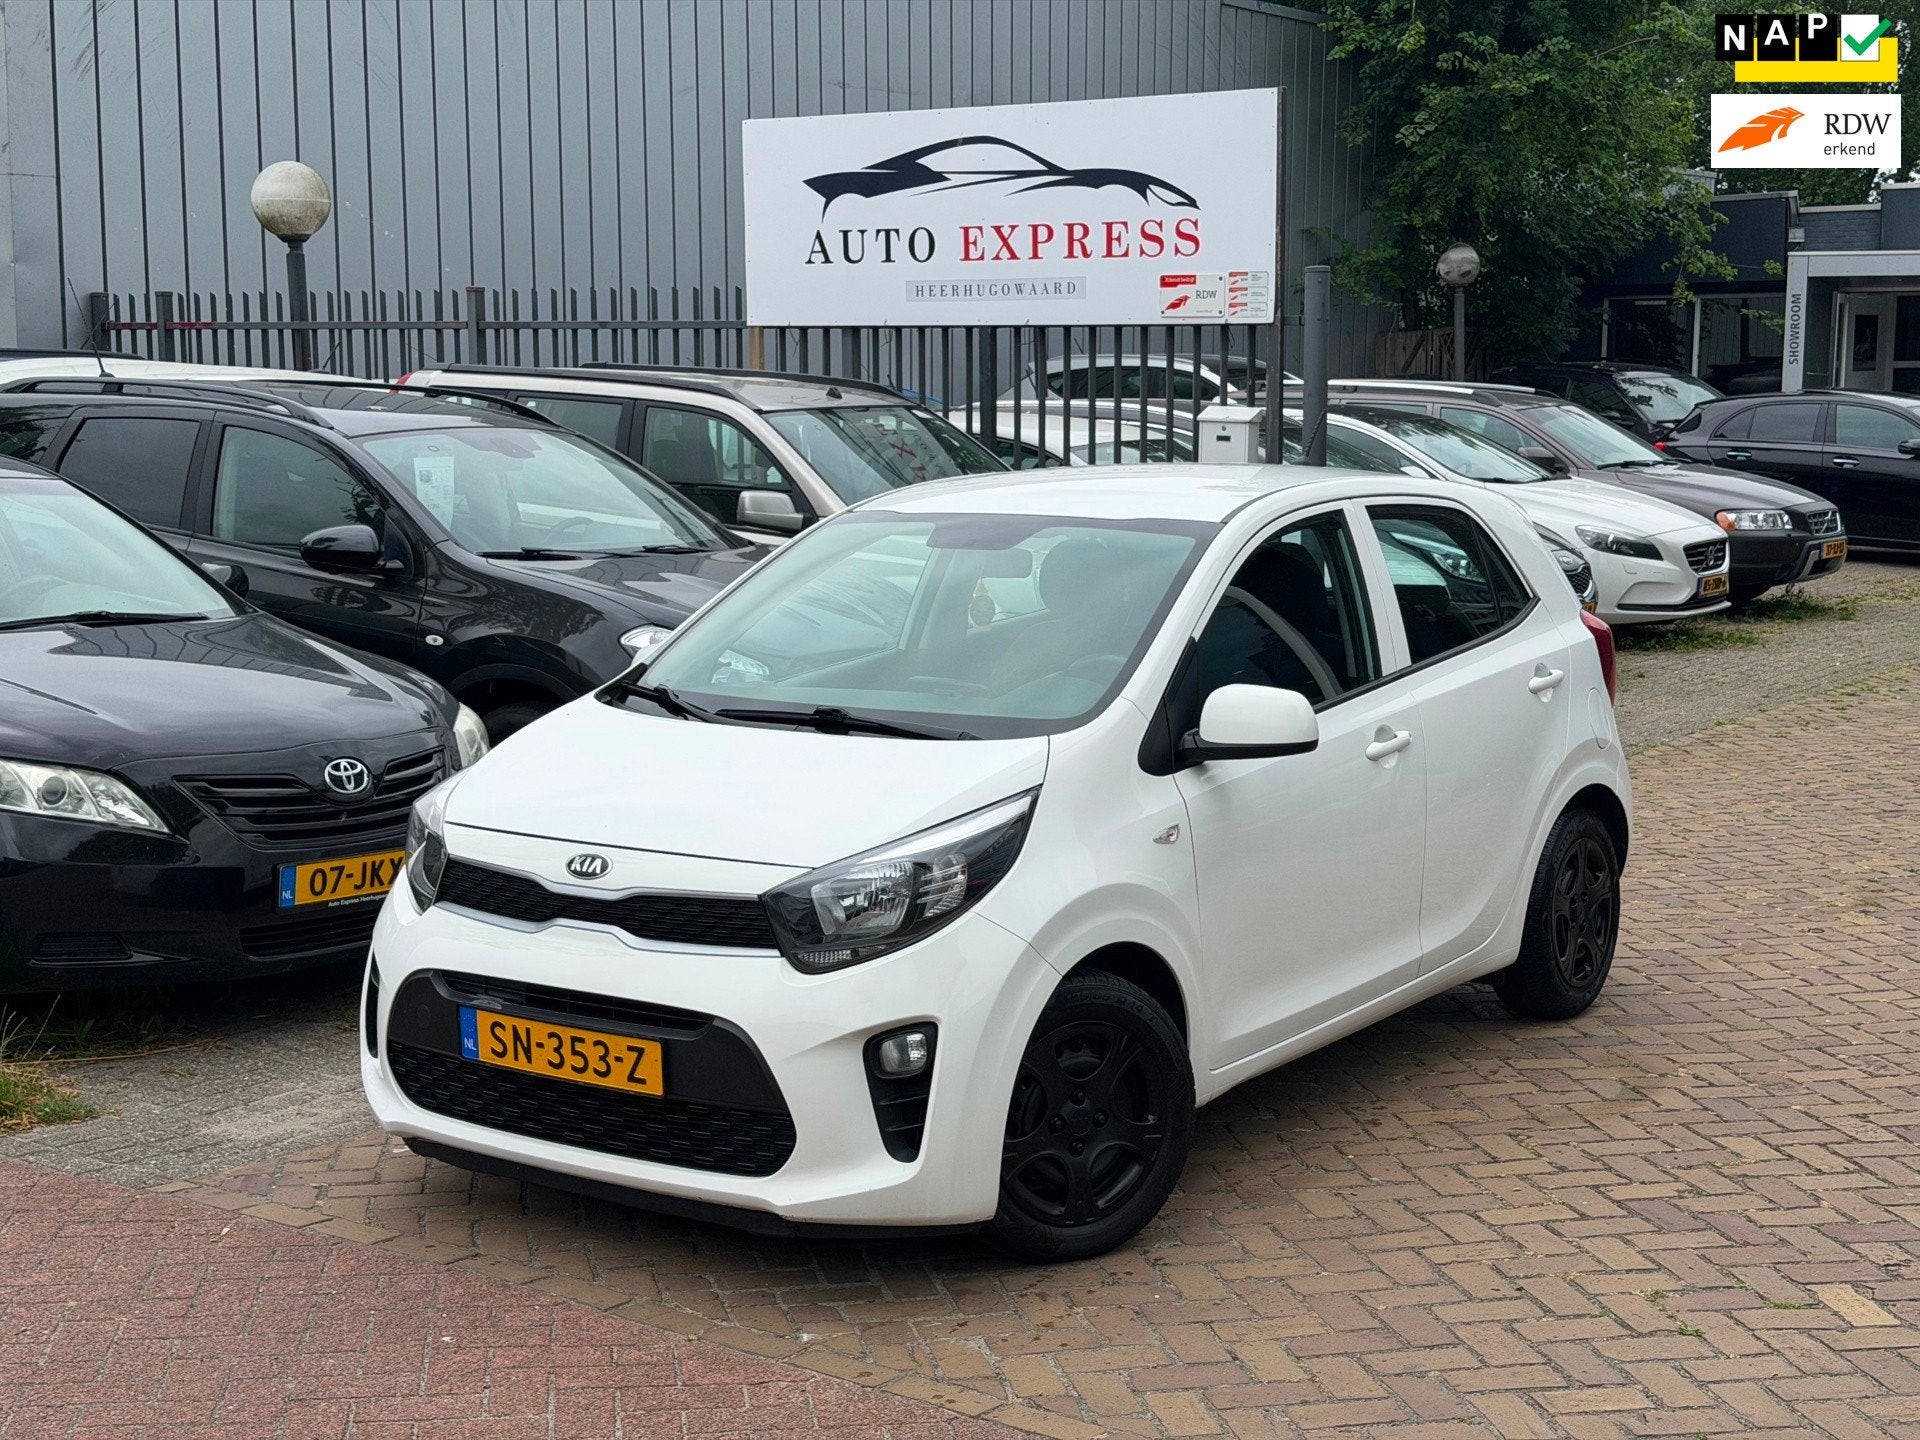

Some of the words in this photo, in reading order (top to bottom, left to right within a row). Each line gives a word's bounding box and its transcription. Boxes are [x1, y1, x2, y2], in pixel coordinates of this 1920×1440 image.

[804, 226, 936, 265] AUTO
[959, 217, 1202, 262] EXPRESS
[914, 280, 1078, 298] HEERHUGOWAARD
[1195, 290, 1218, 299] RDW
[1788, 293, 1802, 365] SHOWROOM
[570, 856, 603, 874] KIA
[282, 890, 293, 900] NL
[463, 1037, 477, 1051] NL
[489, 1020, 647, 1085] SN-353-Z
